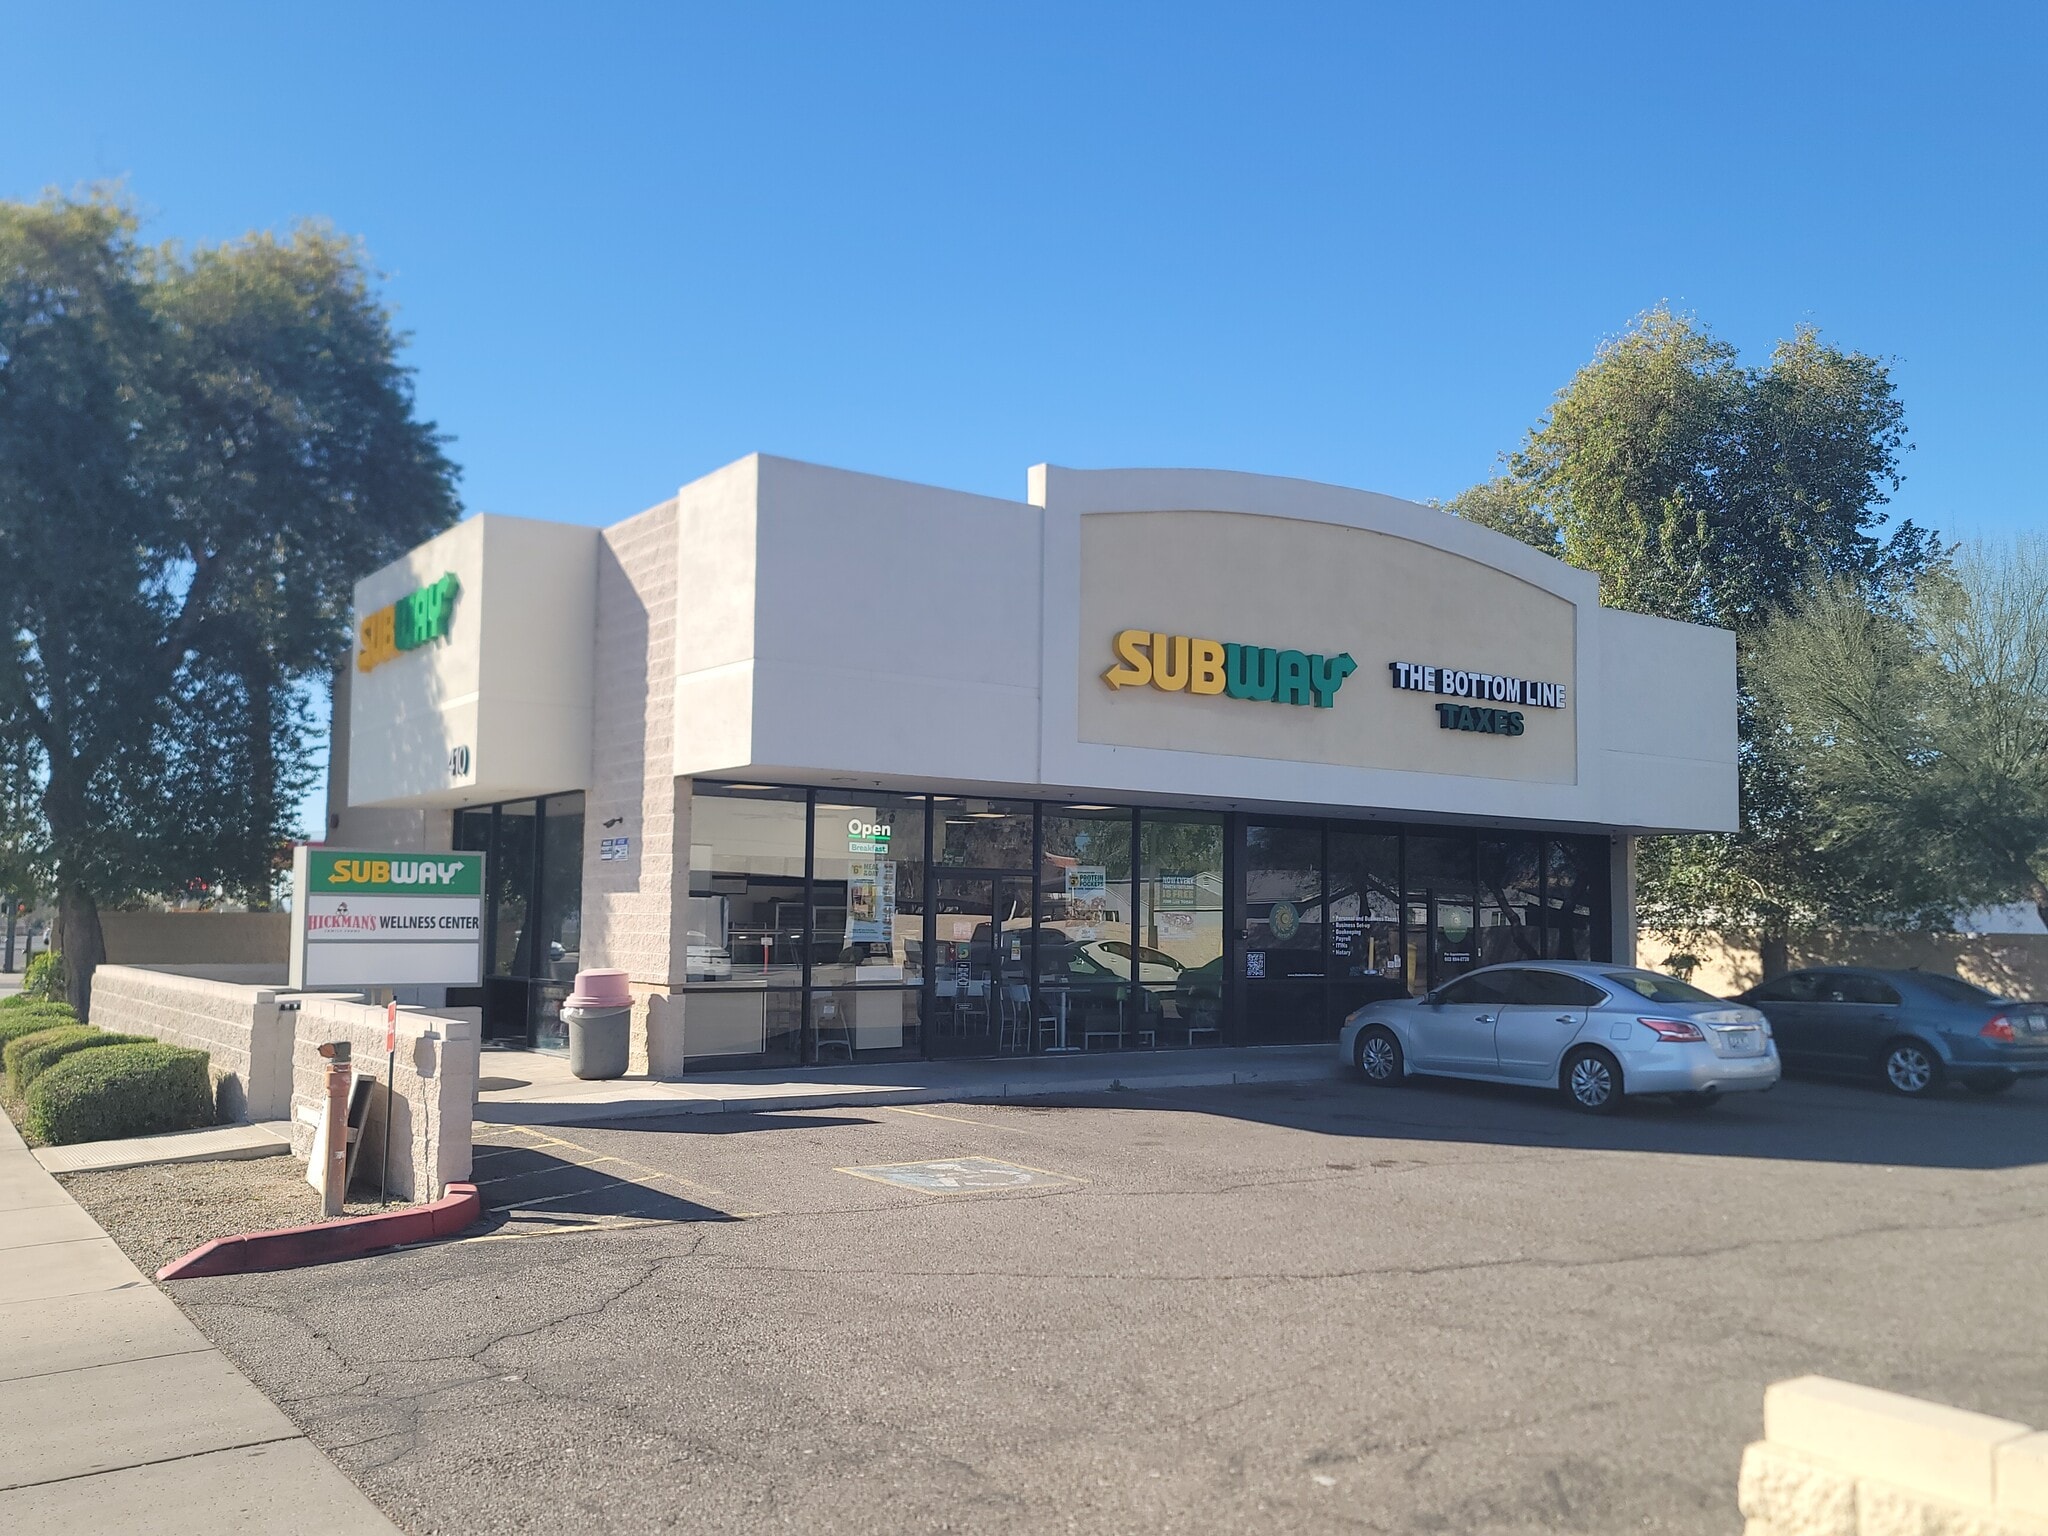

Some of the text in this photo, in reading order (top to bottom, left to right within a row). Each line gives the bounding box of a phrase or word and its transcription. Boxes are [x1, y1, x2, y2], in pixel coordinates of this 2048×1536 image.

[357, 571, 460, 672] SUBWAY
[1101, 629, 1358, 708] SUBWAY
[1392, 662, 1567, 708] THE BOTTOM LINE
[1436, 703, 1525, 736] TAXES
[447, 745, 469, 777] 410
[848, 819, 891, 838] Open
[851, 844, 887, 852] Breakfast
[328, 860, 465, 885] SUBWAY
[308, 913, 479, 932] HICKMAN'S WELLNESS CENTER
